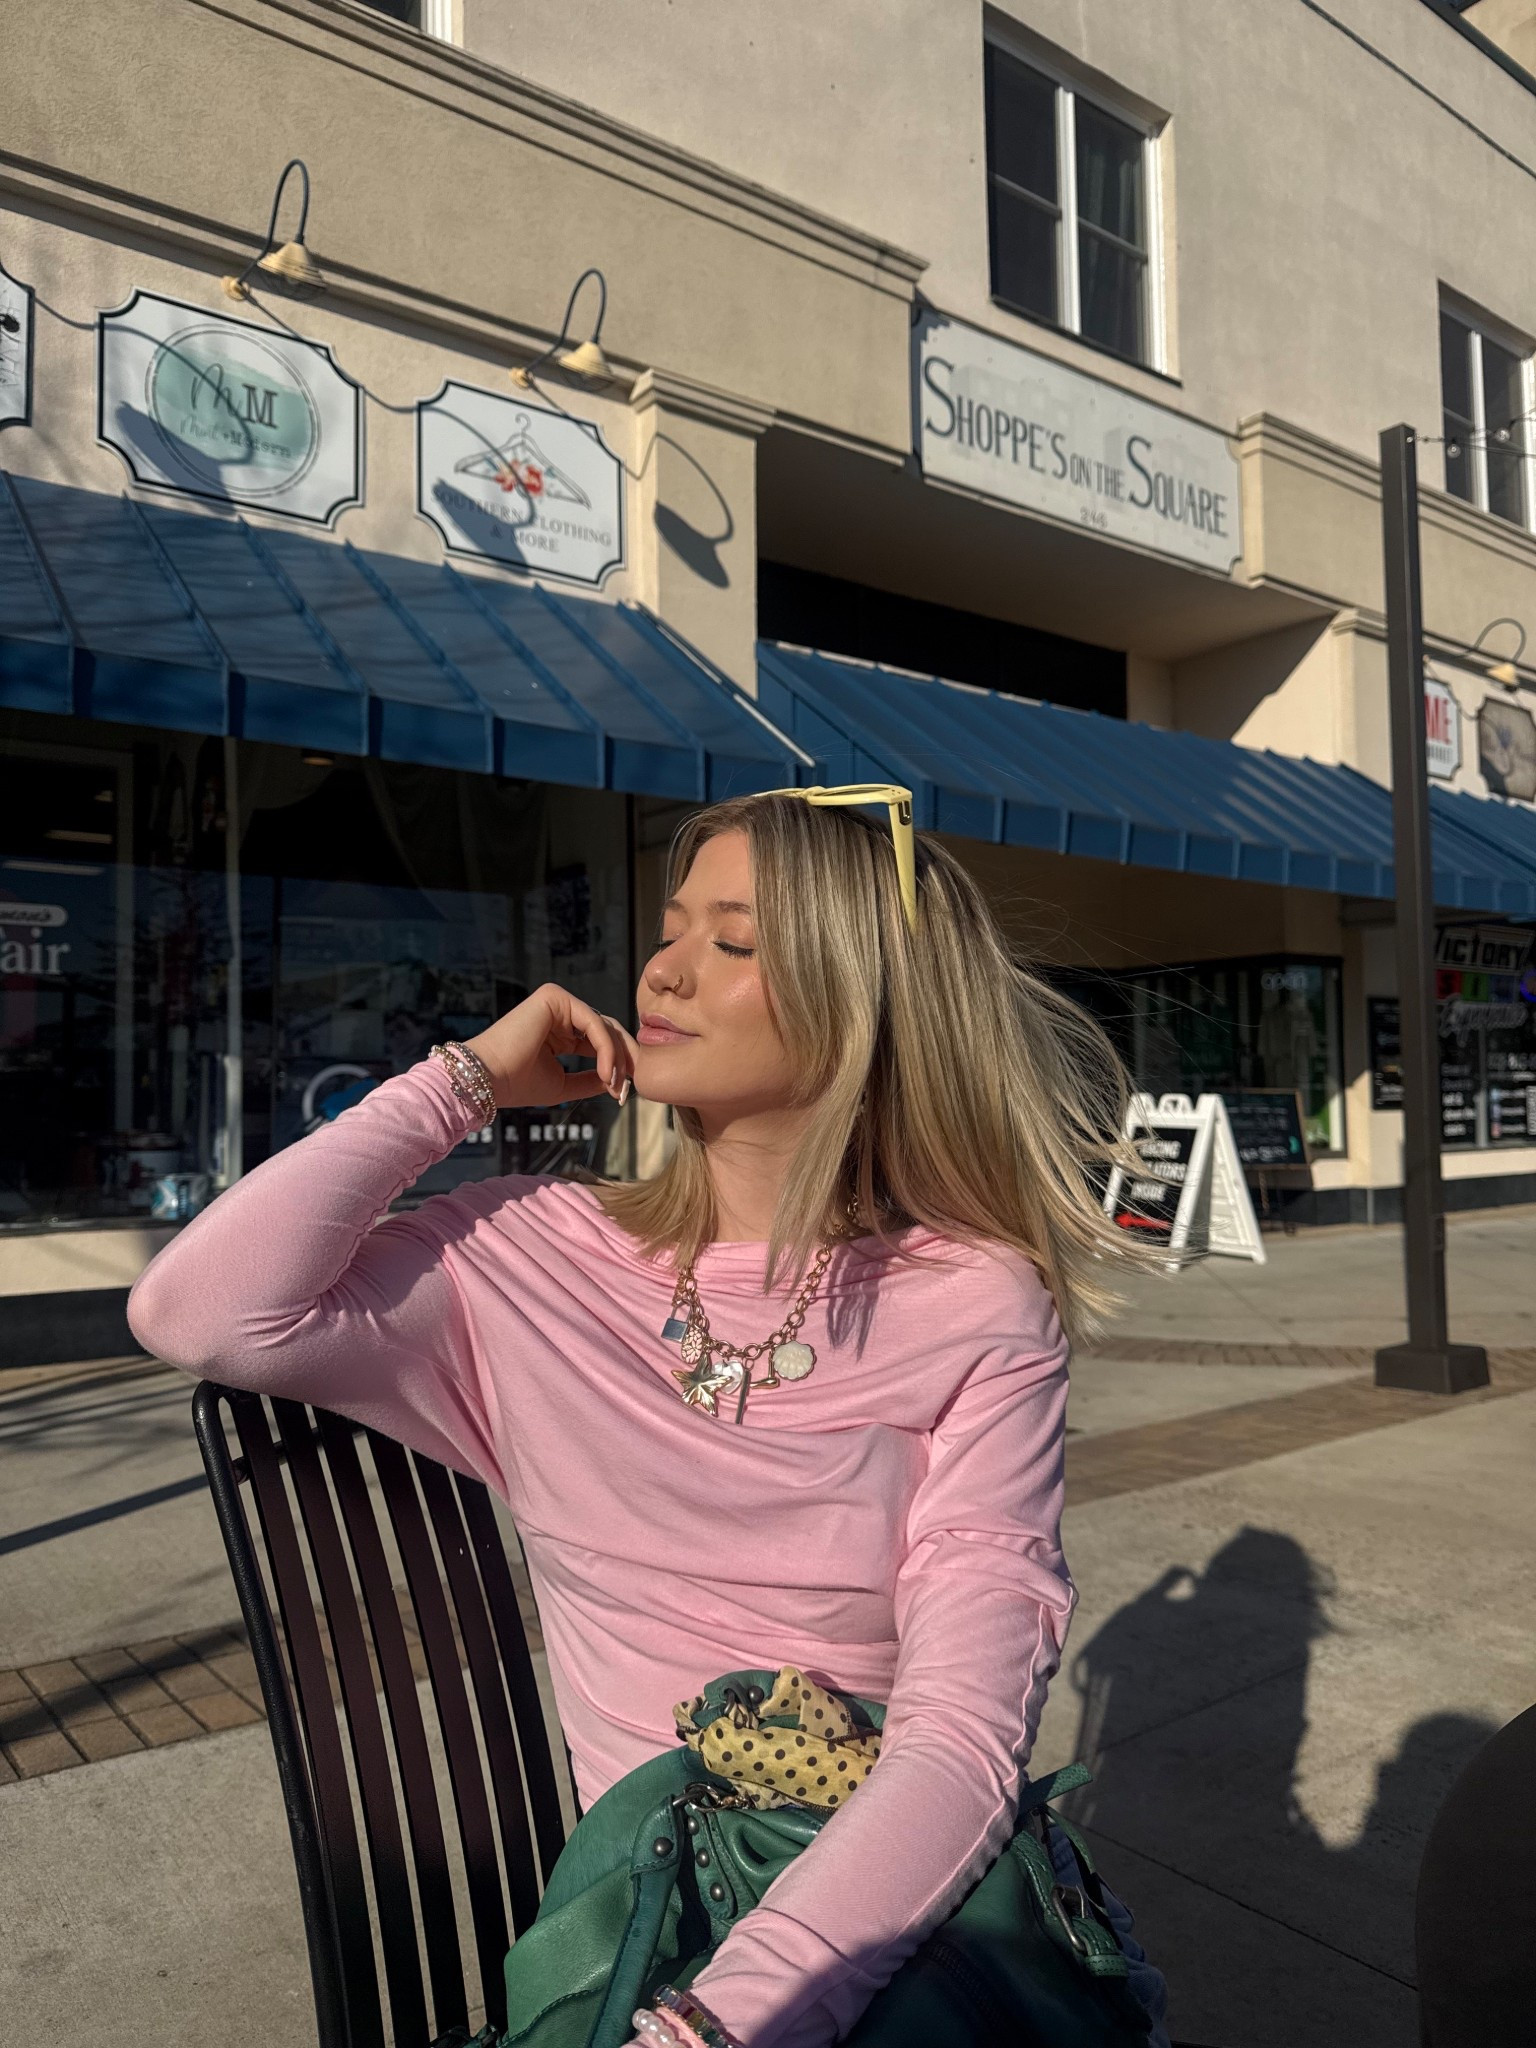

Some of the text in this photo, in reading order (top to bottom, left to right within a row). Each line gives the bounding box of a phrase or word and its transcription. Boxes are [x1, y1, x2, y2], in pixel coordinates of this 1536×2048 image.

[923, 356, 1228, 537] SHOPPE'S ON THE SQUARE
[532, 513, 612, 547] LOTHING
[1424, 694, 1453, 746] ME
[0, 926, 71, 975] air
[530, 1123, 594, 1142] RETRO
